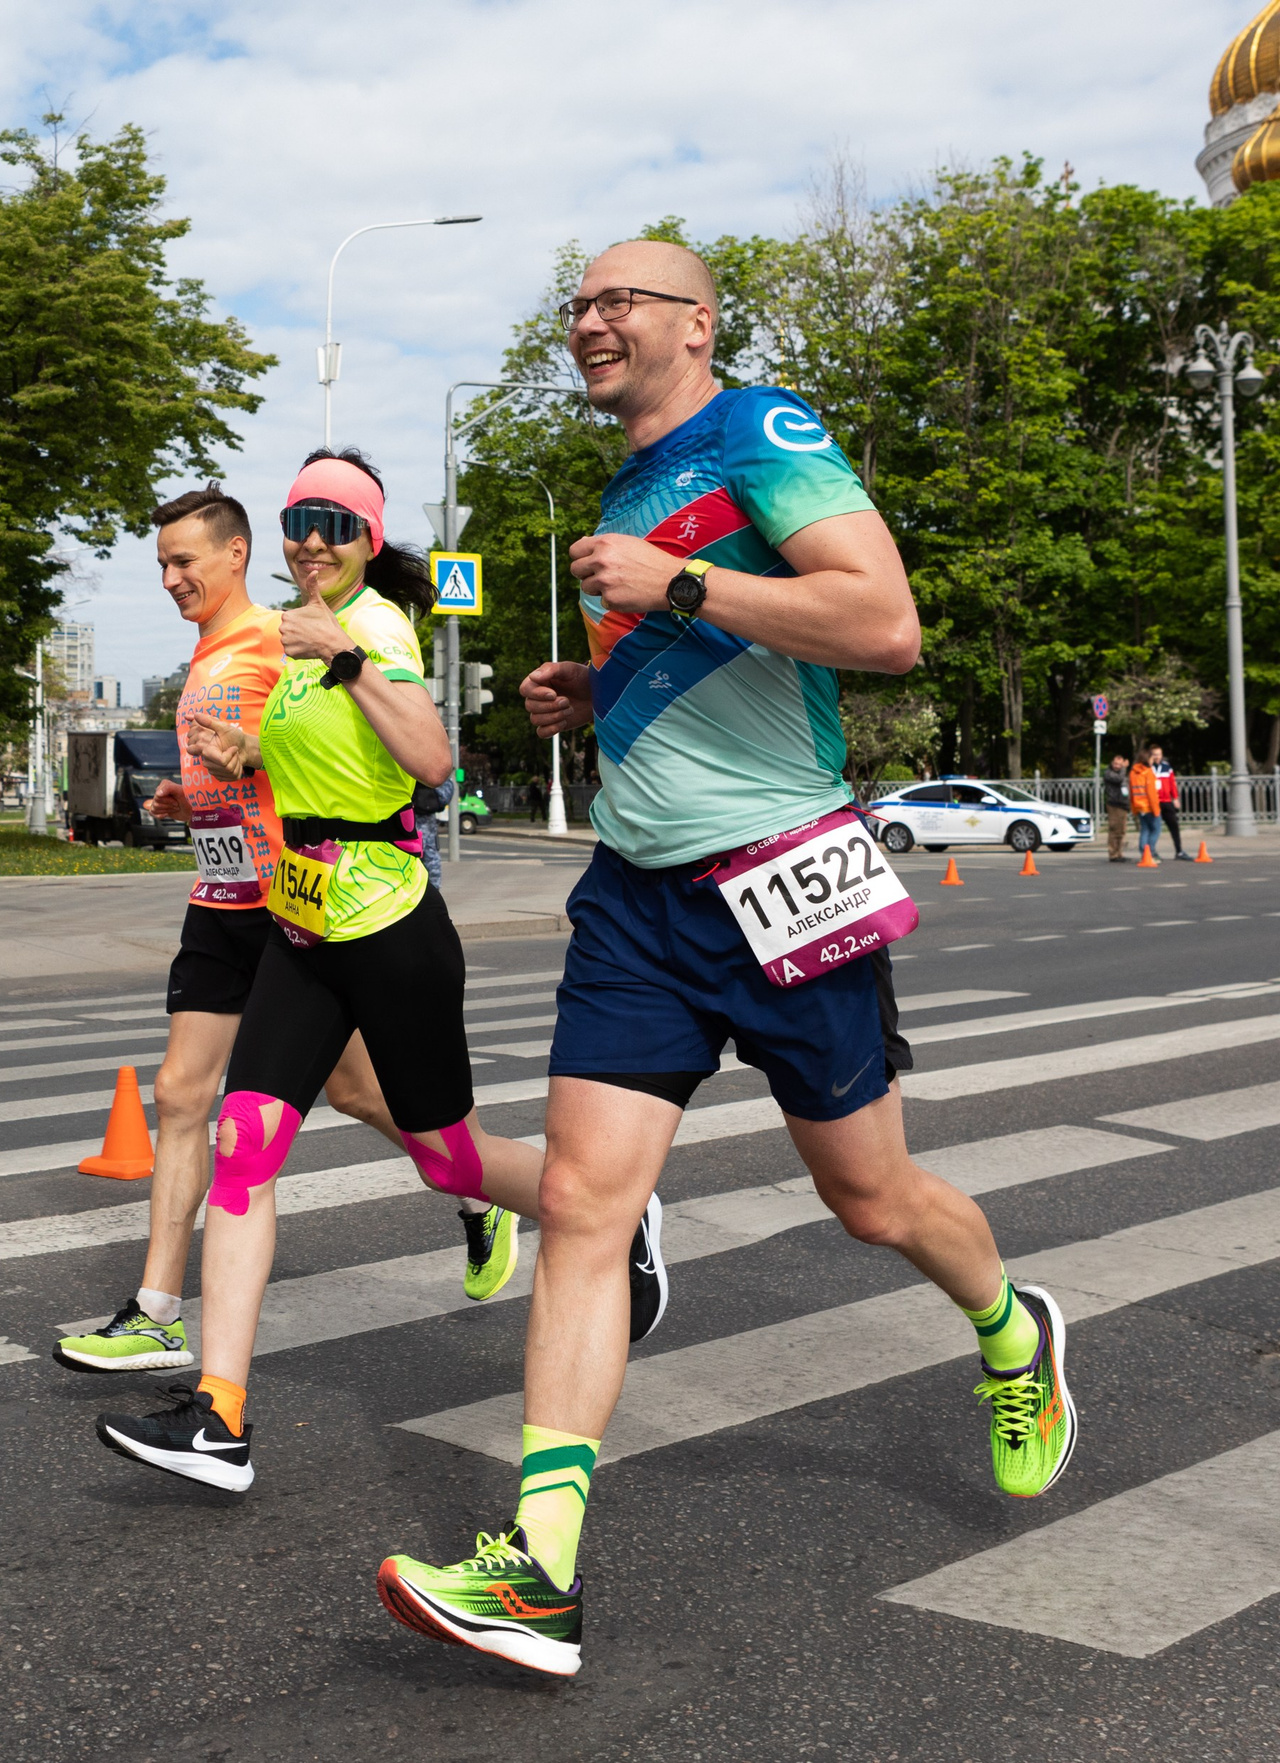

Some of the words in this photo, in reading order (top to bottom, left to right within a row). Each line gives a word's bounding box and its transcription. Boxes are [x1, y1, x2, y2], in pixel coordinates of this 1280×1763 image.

[757, 834, 780, 849] СБЕР
[205, 866, 240, 876] АЛЕКСАНДР
[739, 836, 886, 930] 11522
[285, 901, 299, 916] АННА
[787, 887, 872, 938] АЛЕКСАНДР
